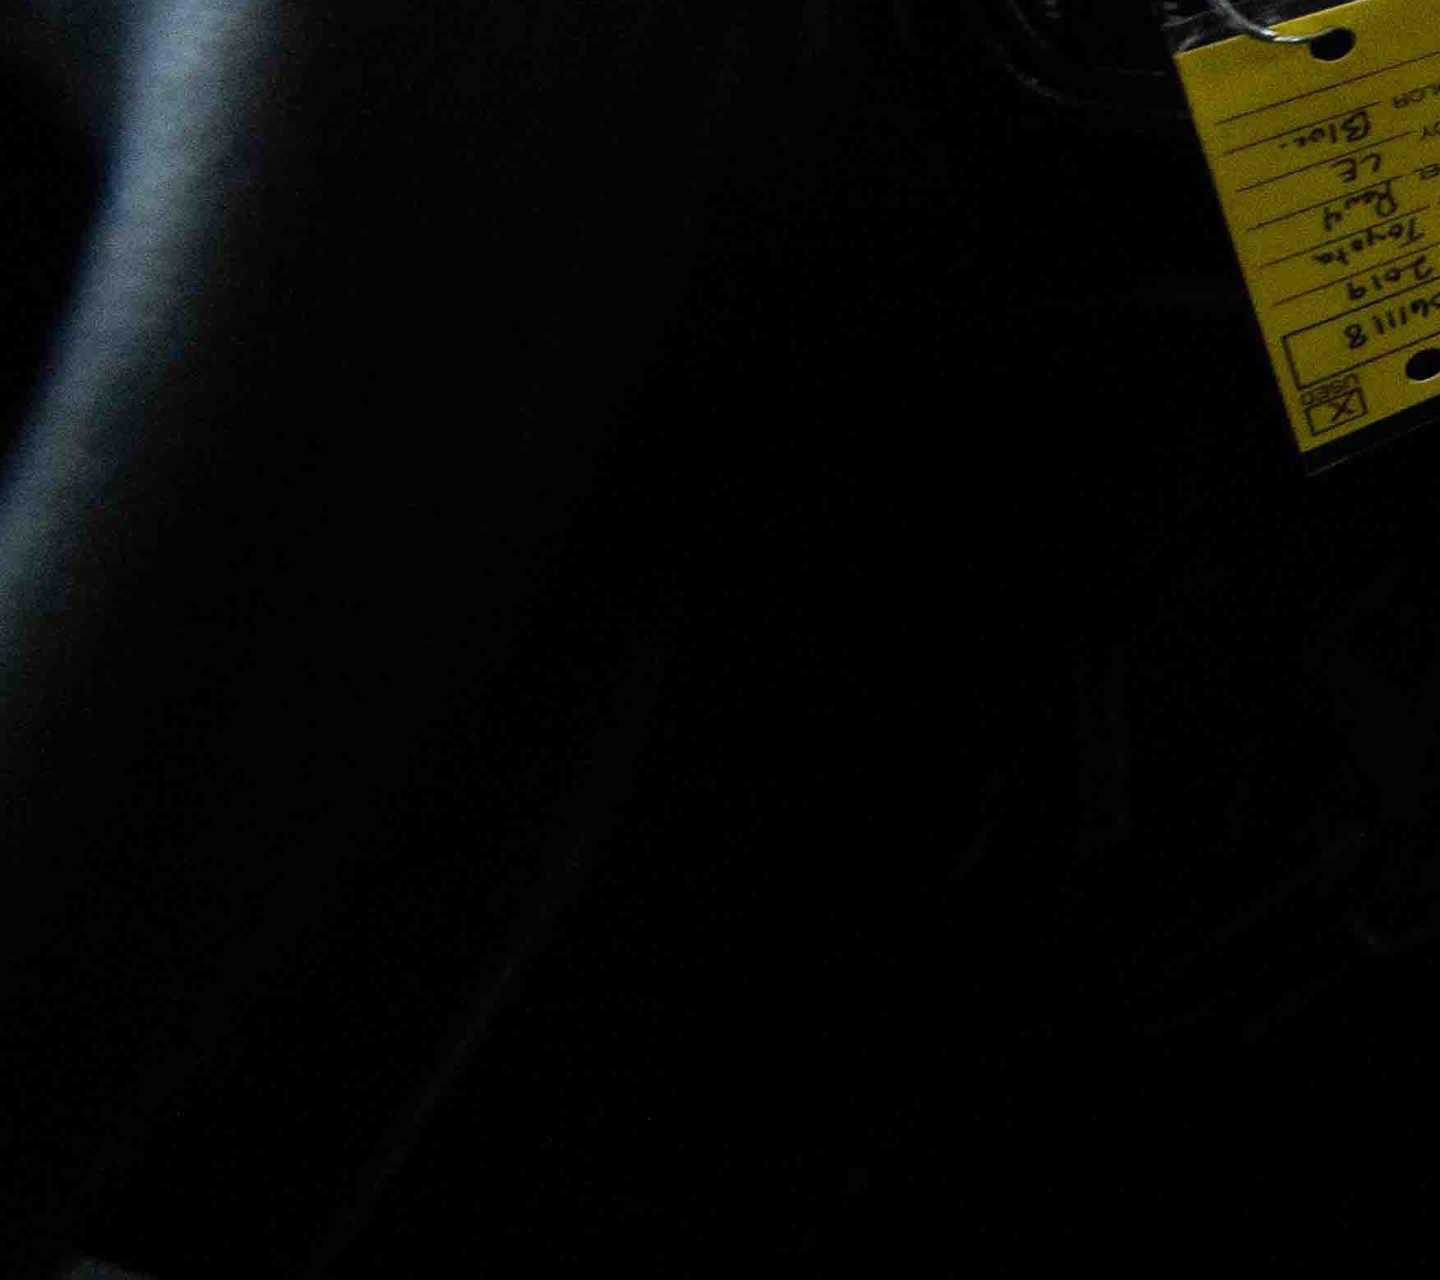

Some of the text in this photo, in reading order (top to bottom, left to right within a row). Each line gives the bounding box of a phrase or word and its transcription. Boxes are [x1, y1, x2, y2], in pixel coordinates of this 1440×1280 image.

[1311, 216, 1426, 267] Toyota
[1346, 253, 1435, 302] 2019
[1301, 373, 1361, 408] USED
